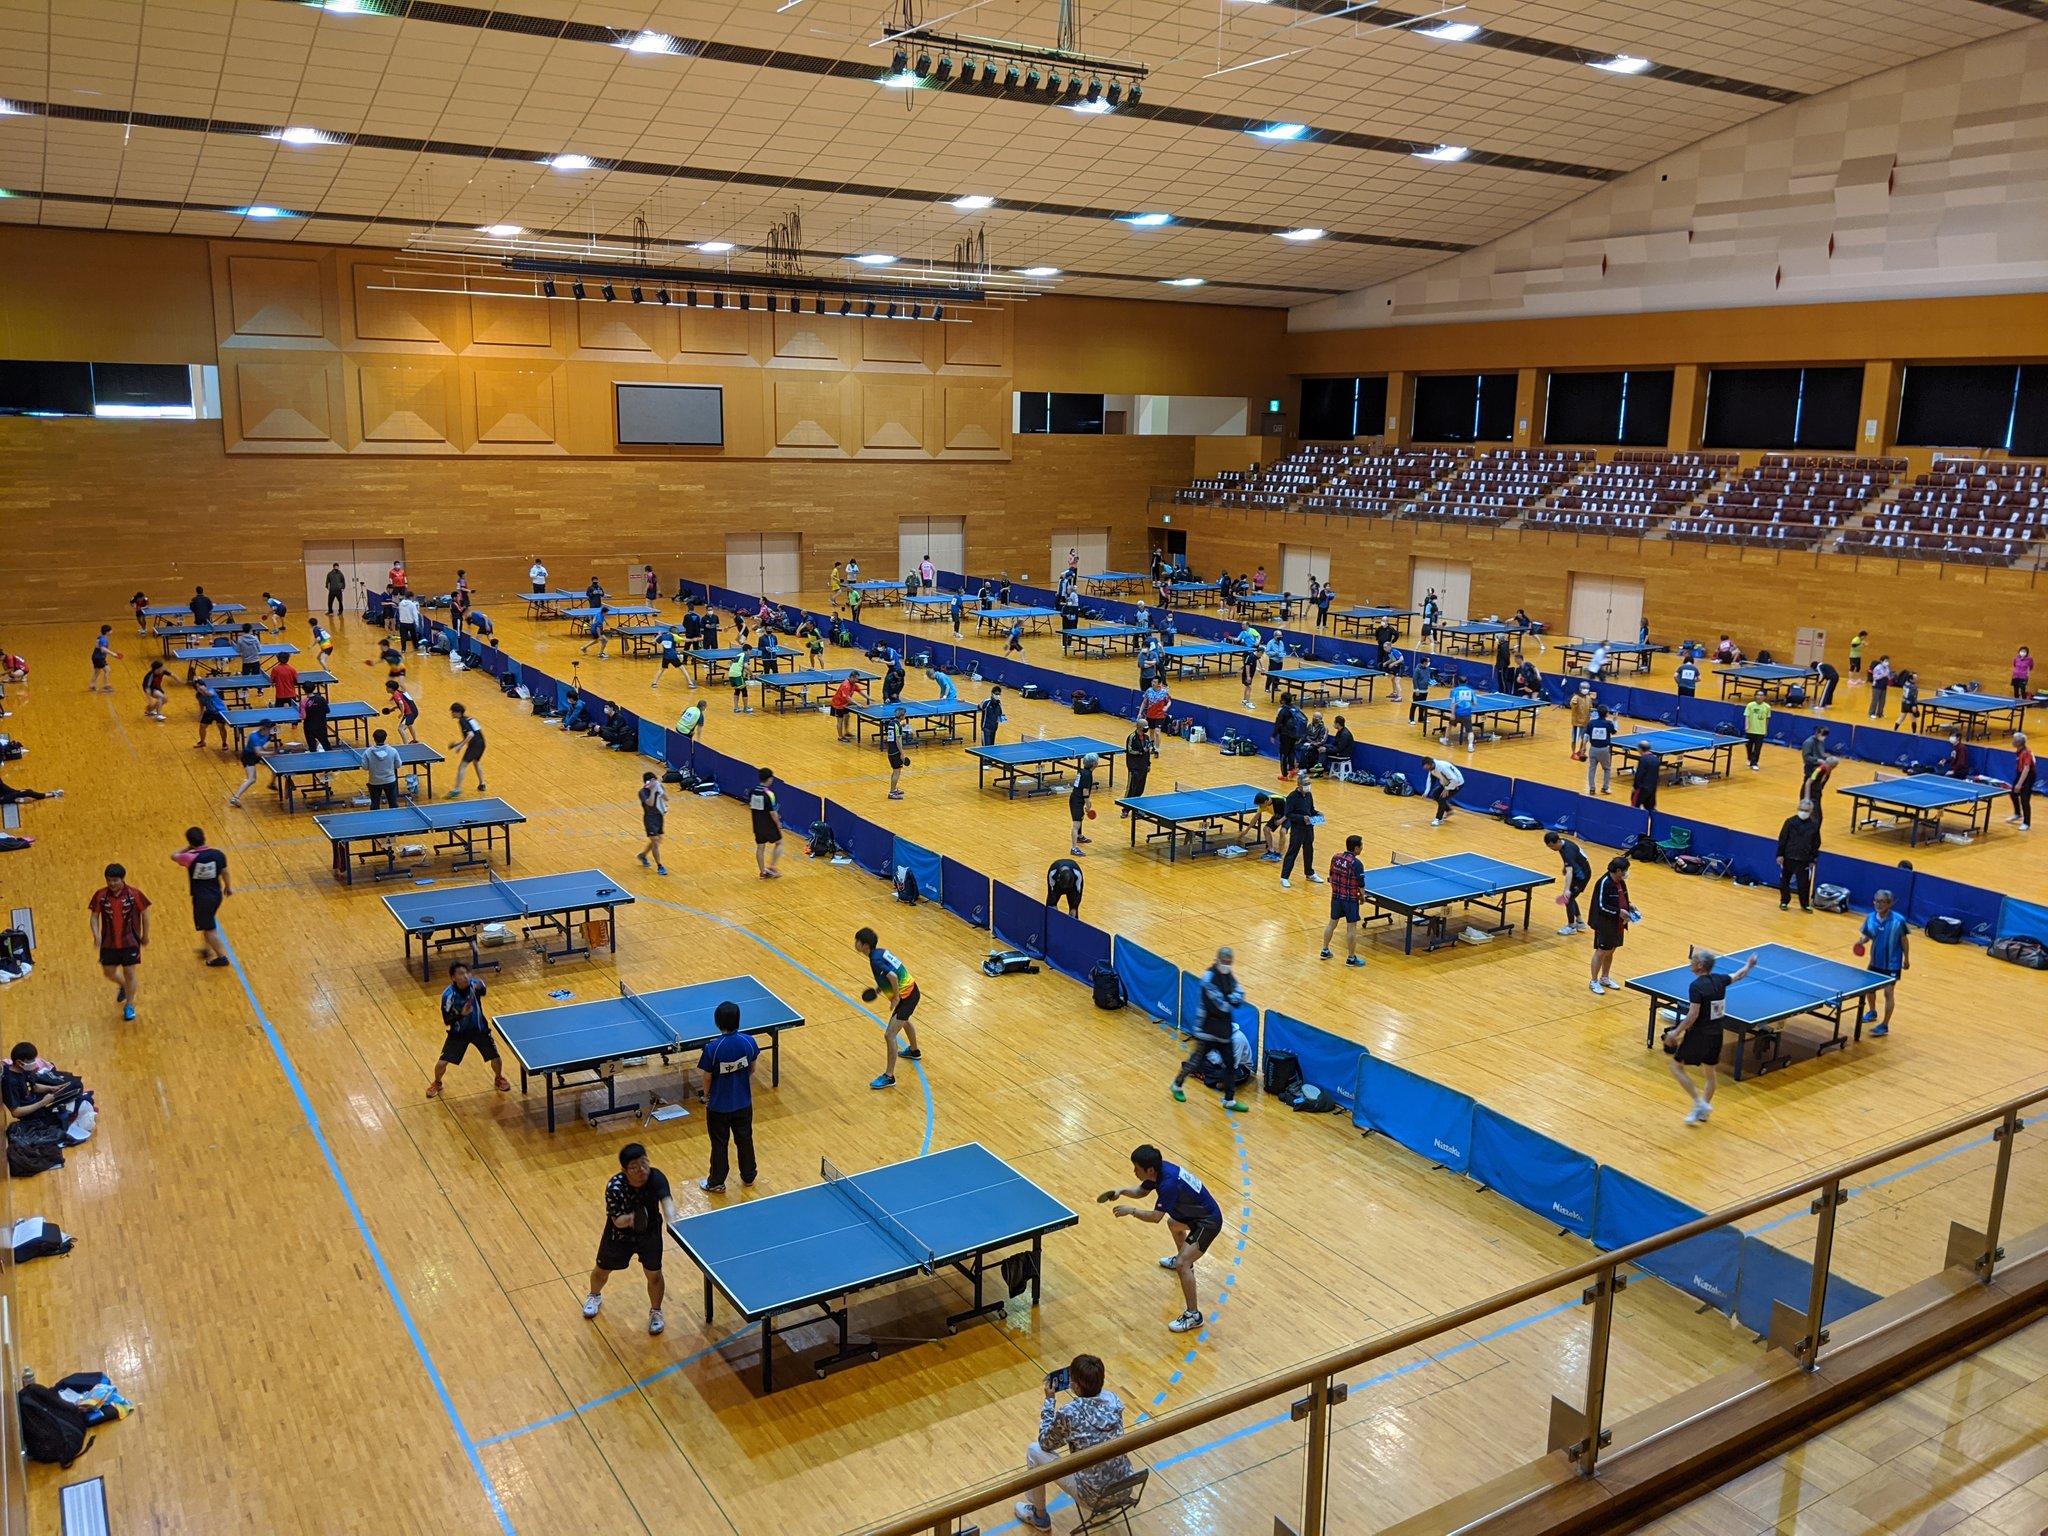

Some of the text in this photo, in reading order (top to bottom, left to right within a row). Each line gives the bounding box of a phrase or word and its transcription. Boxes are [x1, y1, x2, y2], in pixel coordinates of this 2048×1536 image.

[608, 1063, 616, 1073] 2
[1434, 1138, 1461, 1158] Nittaku
[1552, 1201, 1584, 1222] Nittaku
[1693, 1274, 1727, 1298] Nittaku
